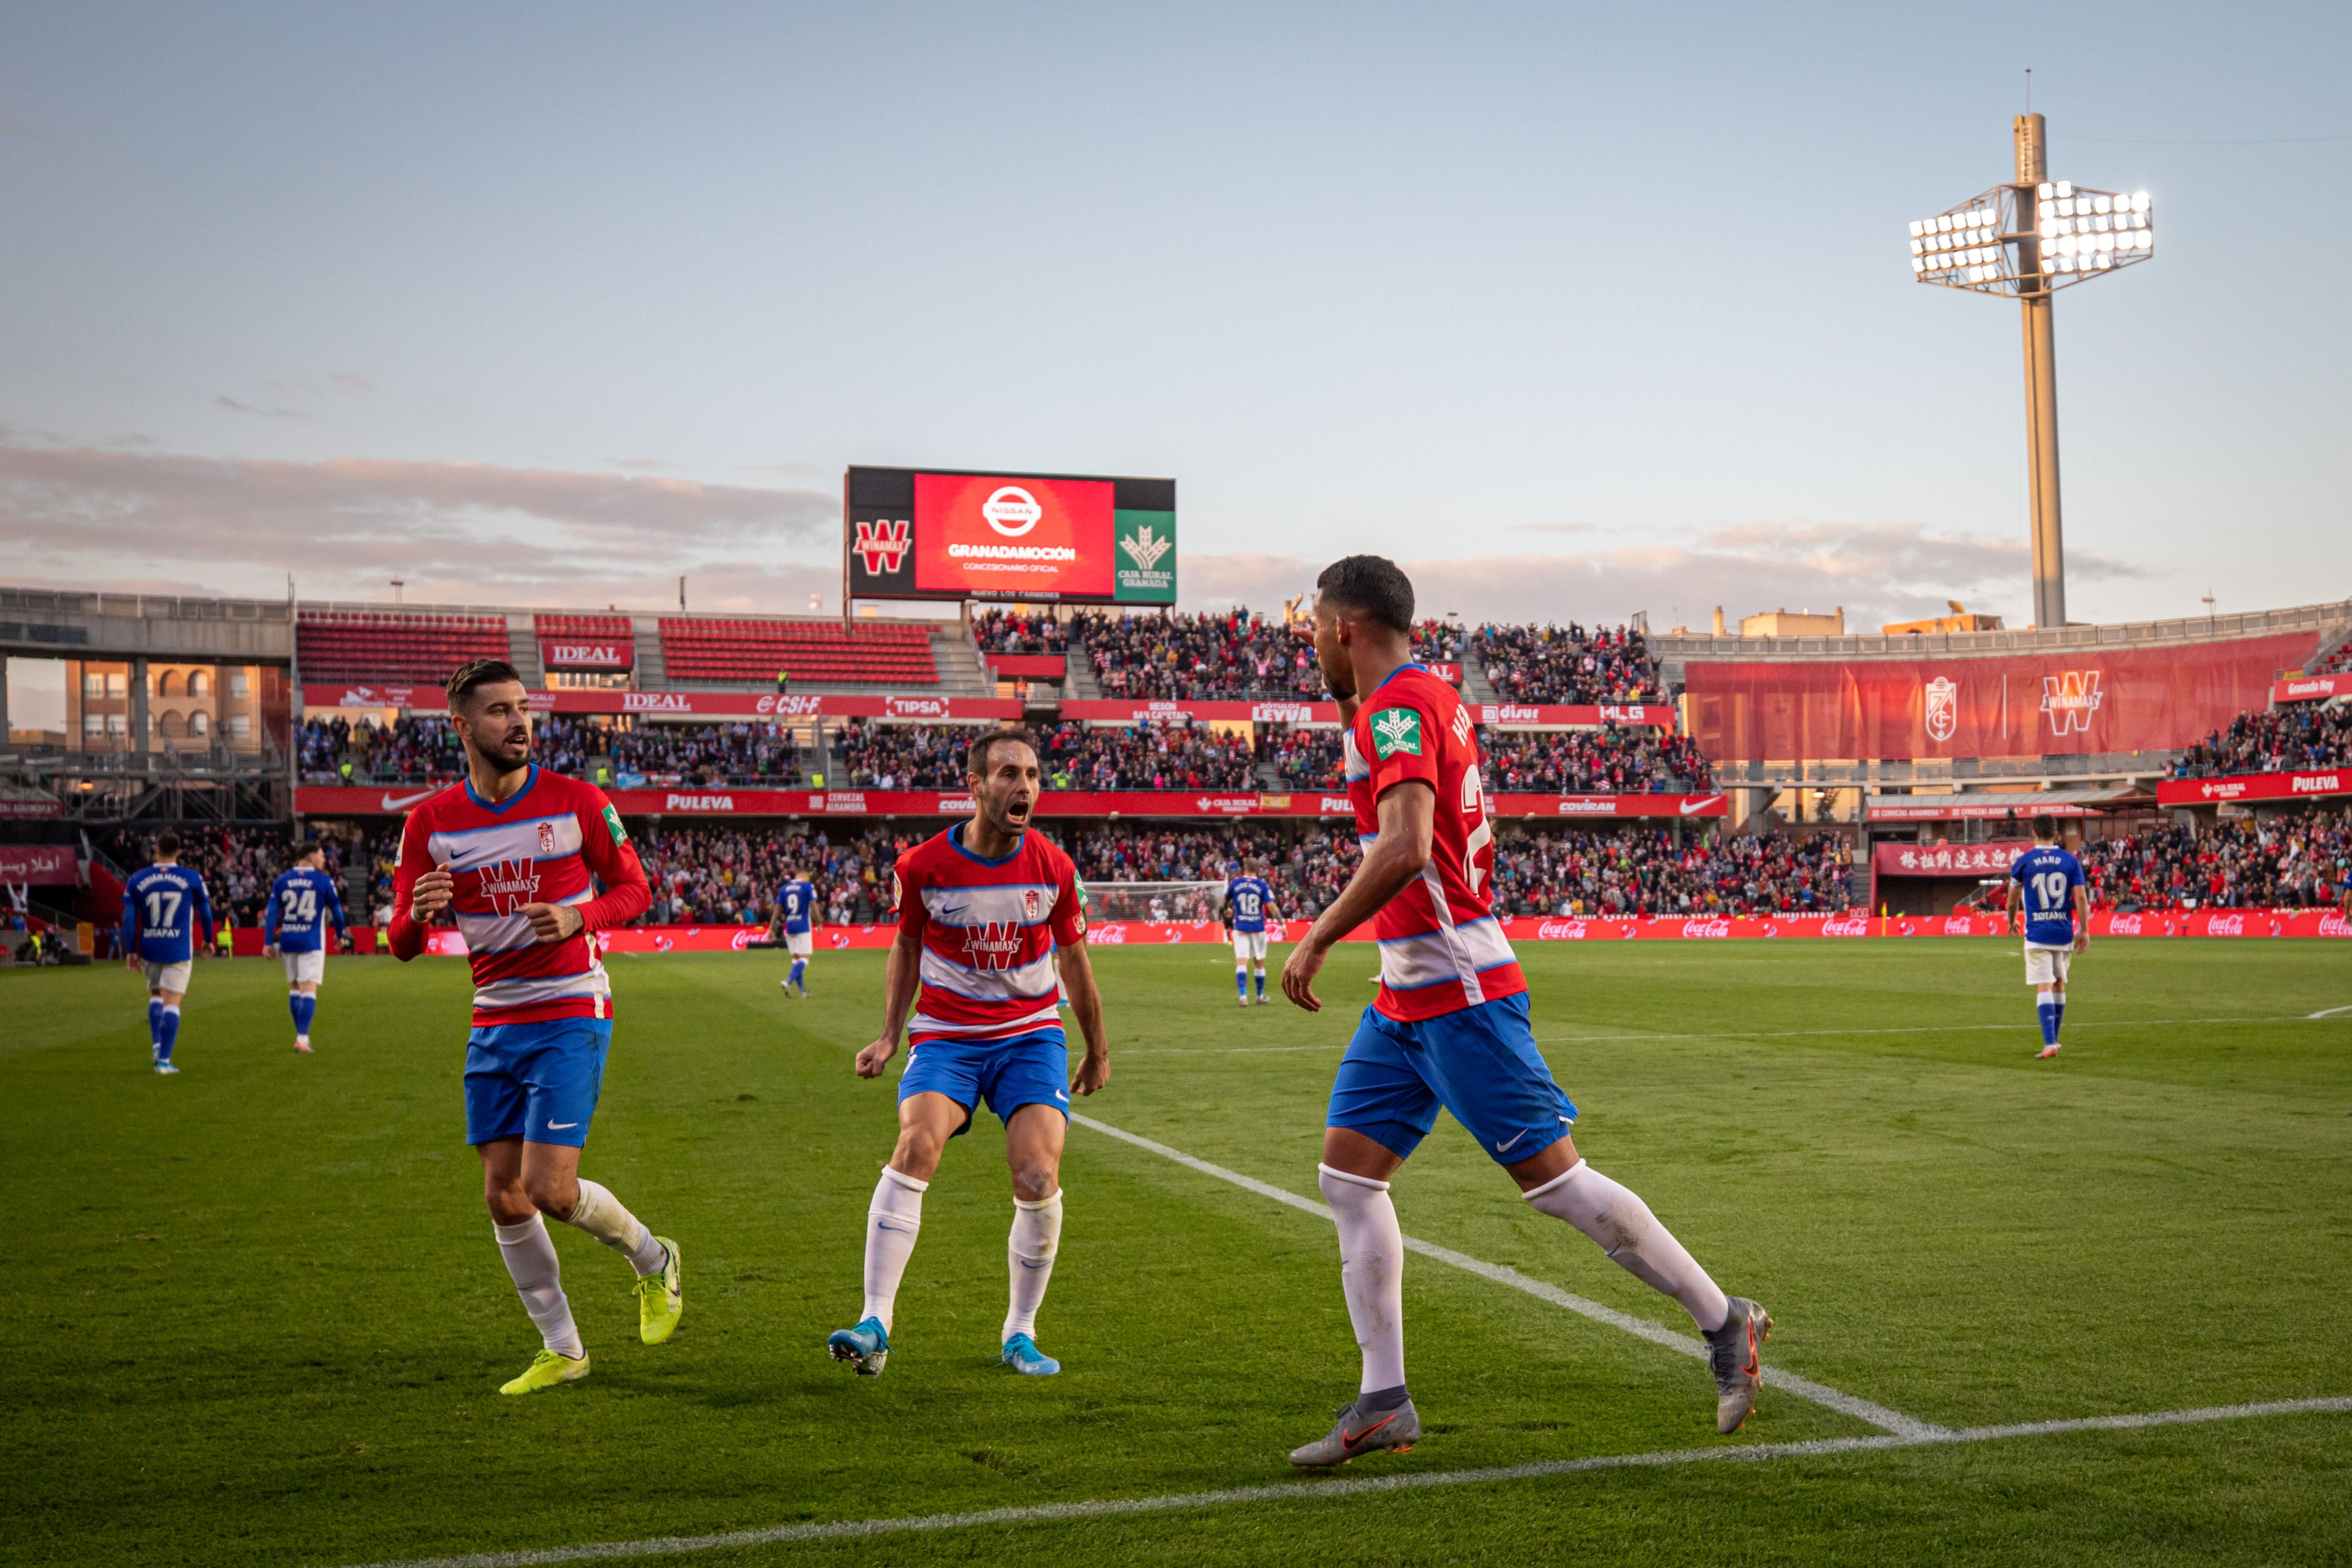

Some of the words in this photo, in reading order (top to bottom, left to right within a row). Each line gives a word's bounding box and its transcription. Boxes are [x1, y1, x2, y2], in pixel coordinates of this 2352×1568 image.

[992, 507, 1032, 515] NISSAN
[861, 540, 904, 551] WINAMAX
[948, 544, 1075, 560] GRANADAMOCIÓN
[963, 563, 1027, 572] CONCESIONARIO
[1029, 565, 1059, 573] OFICIAL
[1118, 570, 1140, 578] CAJA
[1142, 571, 1173, 579] RURAL
[1122, 579, 1169, 588] GRANADA
[553, 646, 620, 661] IDEAL
[2288, 681, 2318, 695] Granada
[2320, 679, 2335, 694] Hoy
[623, 694, 691, 708] IDEAL
[894, 701, 941, 714] TIPSA
[2049, 695, 2093, 708] WINAMAX
[1133, 711, 1149, 719] SAN
[1252, 706, 1312, 721] LEYVA
[1500, 704, 1539, 718] disur
[1600, 706, 1644, 719] MLG
[1380, 742, 1393, 754] CAJA
[1394, 739, 1418, 749] RURAL
[2293, 776, 2340, 792] PULEVA
[666, 794, 734, 810] PULEVA
[828, 792, 864, 802] CERVEZAS
[826, 802, 866, 812] ALHAMBRA
[2033, 855, 2061, 866] MANU
[487, 879, 532, 894] WINAMAX
[2032, 872, 2067, 909] 19
[146, 891, 182, 927] 17
[281, 889, 317, 922] 24
[788, 894, 798, 914] 9
[1237, 892, 1260, 915] 18
[971, 940, 1013, 952] WINAMAX
